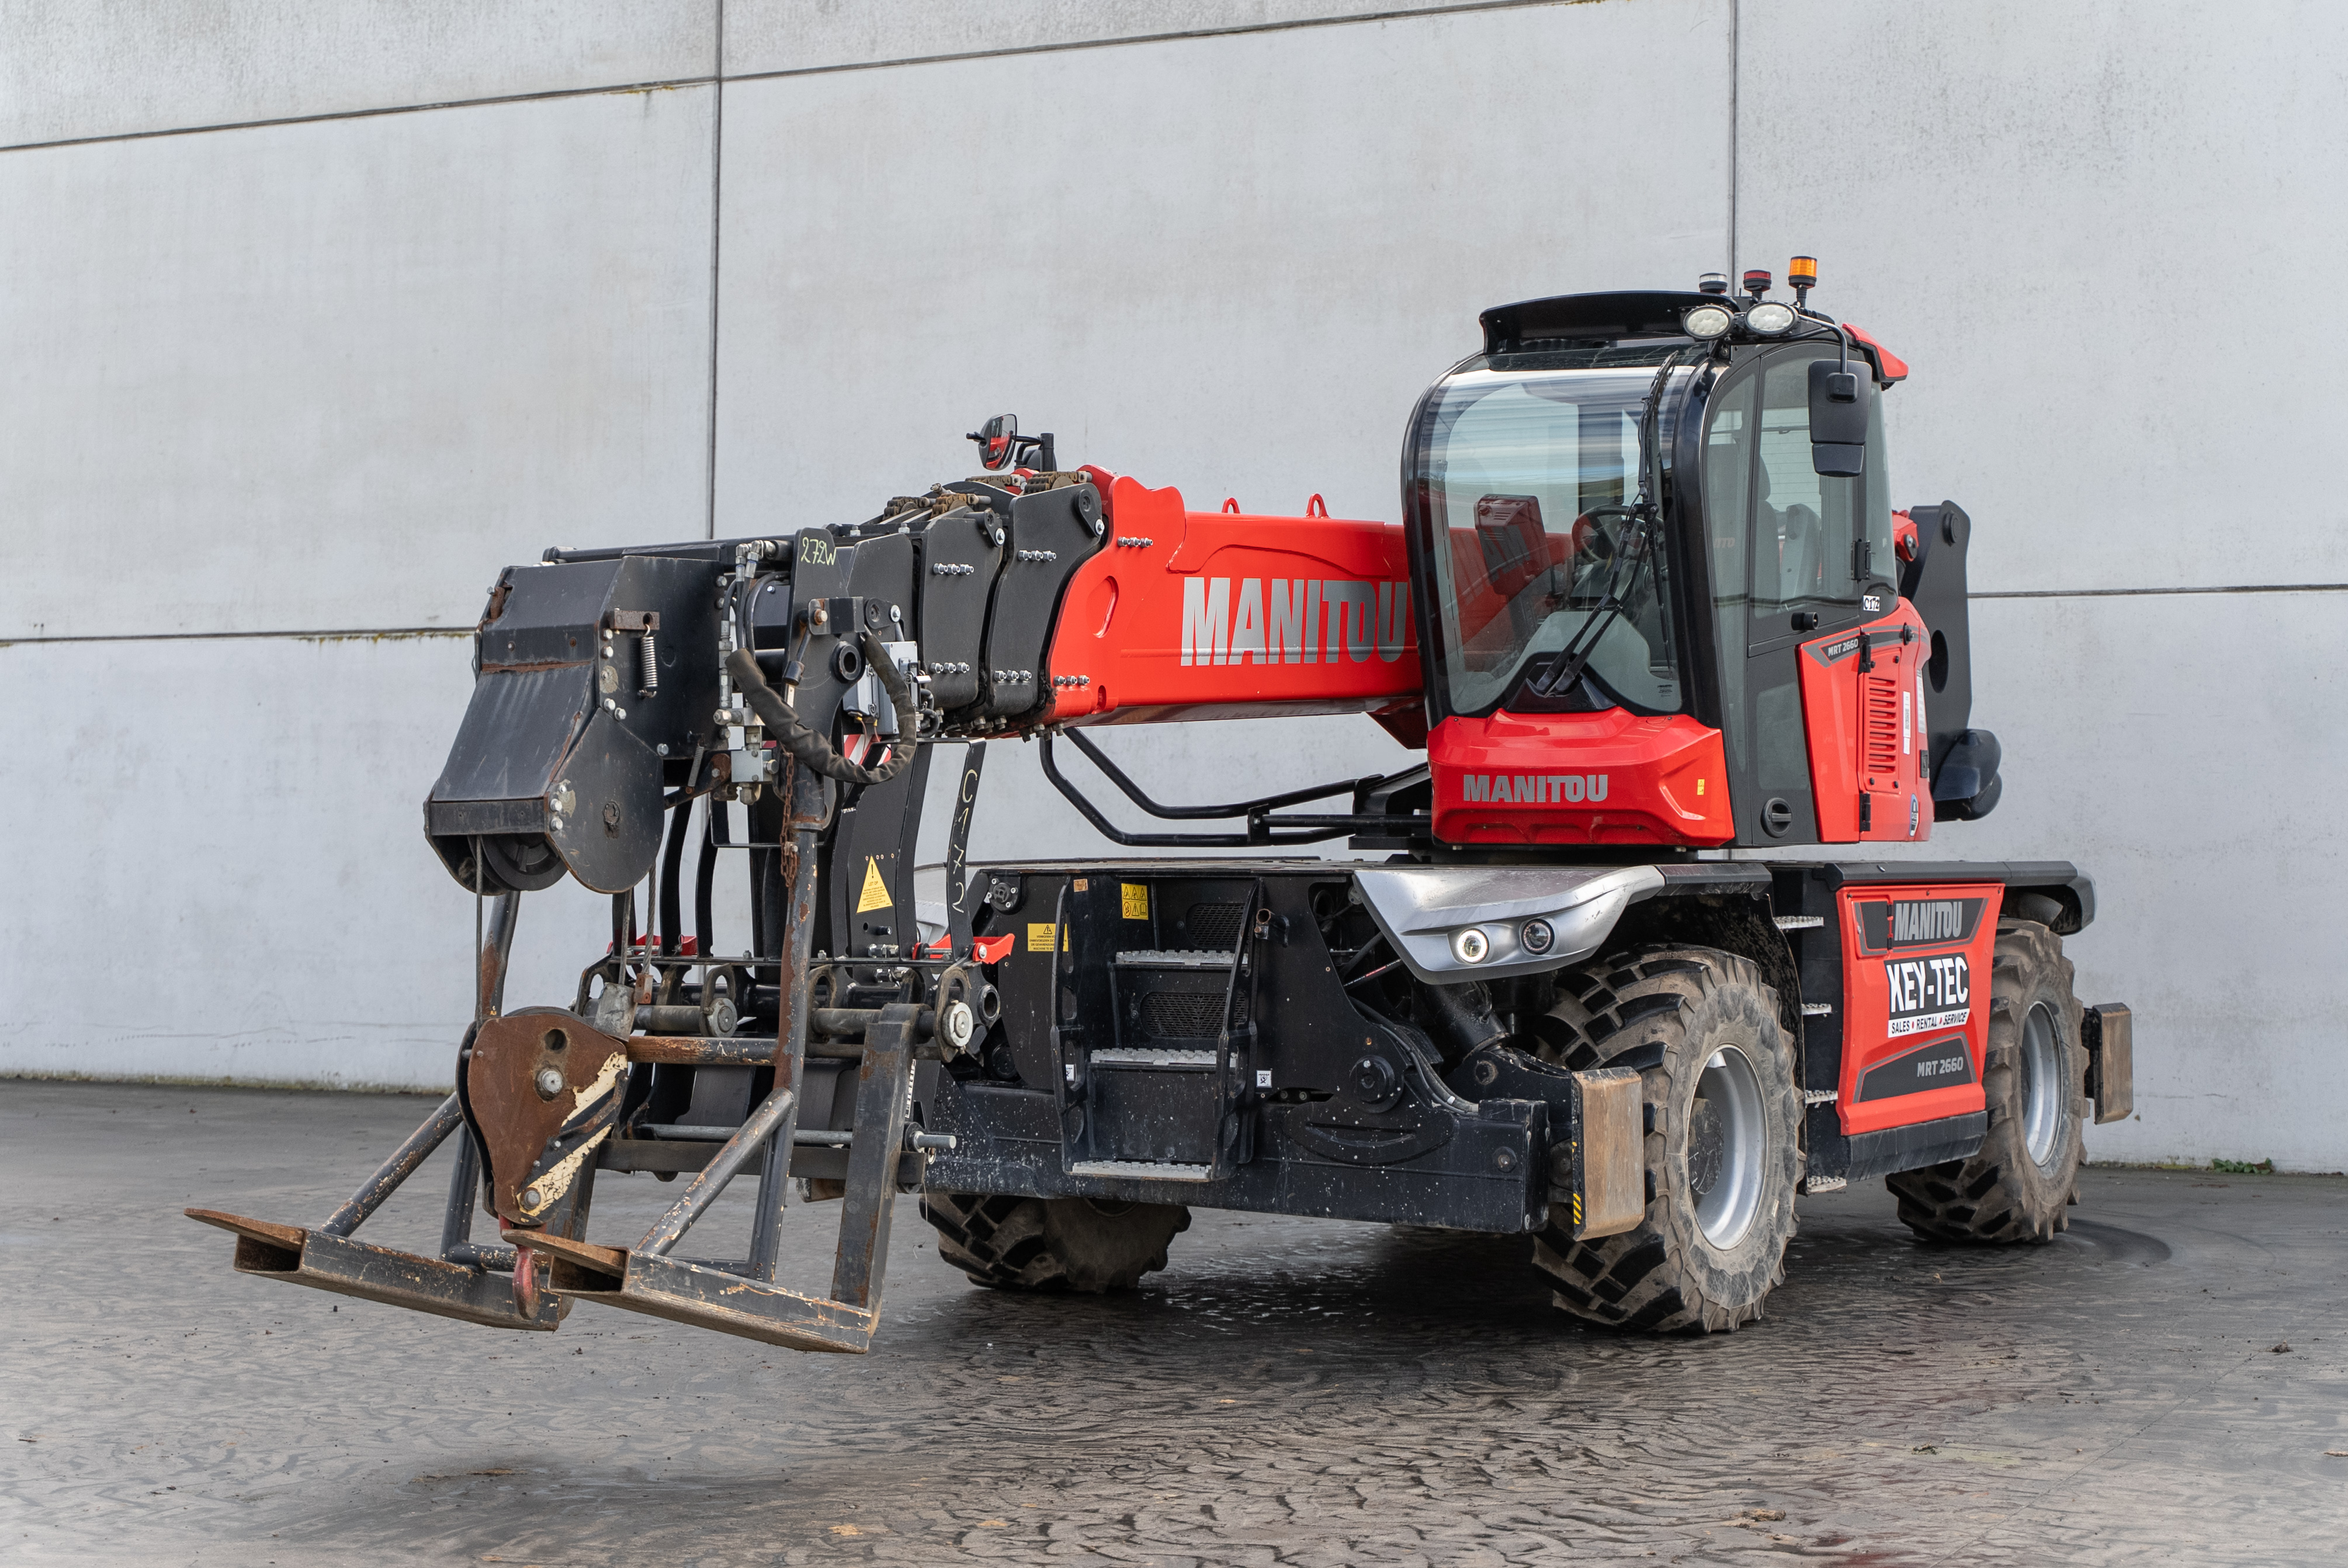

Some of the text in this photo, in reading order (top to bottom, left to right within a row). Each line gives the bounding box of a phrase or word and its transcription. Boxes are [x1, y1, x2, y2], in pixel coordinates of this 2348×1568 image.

[800, 536, 837, 566] 272W
[1180, 577, 1408, 667] MANITOU
[1827, 638, 1858, 657] MRT 2660
[1463, 774, 1608, 803] MANITOU
[1894, 901, 1963, 941] MANITOU
[1886, 956, 1968, 1012] KEY-TEC
[1892, 1011, 1967, 1034] SALES RENTAL SERVICE
[1917, 1056, 1964, 1077] MRT 2660
